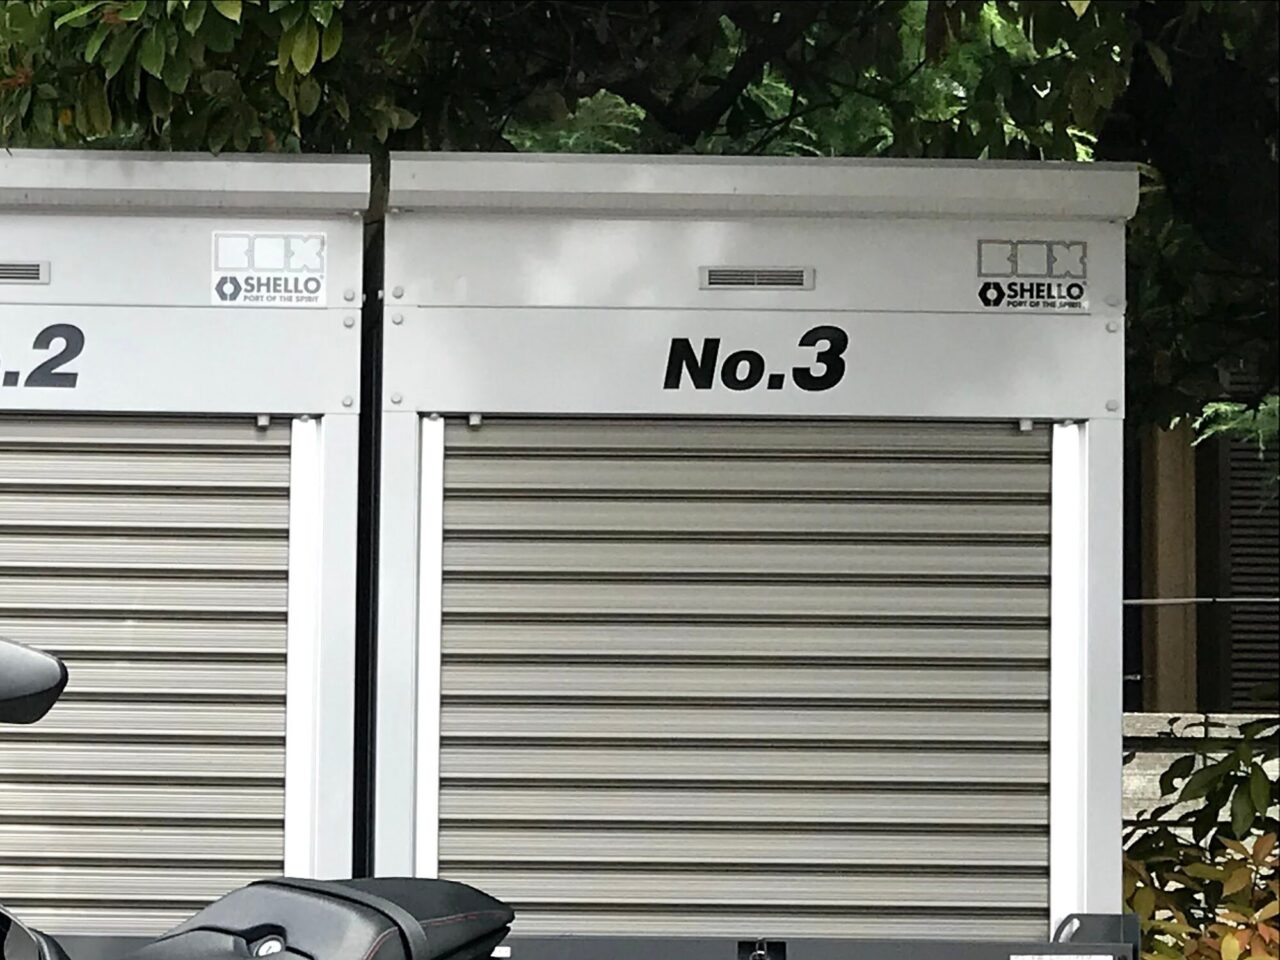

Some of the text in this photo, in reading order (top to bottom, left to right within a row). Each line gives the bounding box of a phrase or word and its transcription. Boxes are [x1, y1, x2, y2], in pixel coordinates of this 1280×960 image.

[243, 276, 321, 294] SHELLO
[1007, 281, 1084, 300] SHELLO
[243, 294, 320, 303] PORT OF THE SPIRIT
[1007, 300, 1028, 308] PORT
[1029, 300, 1040, 308] OF
[1042, 300, 1057, 308] THE
[663, 325, 849, 392] No.3
